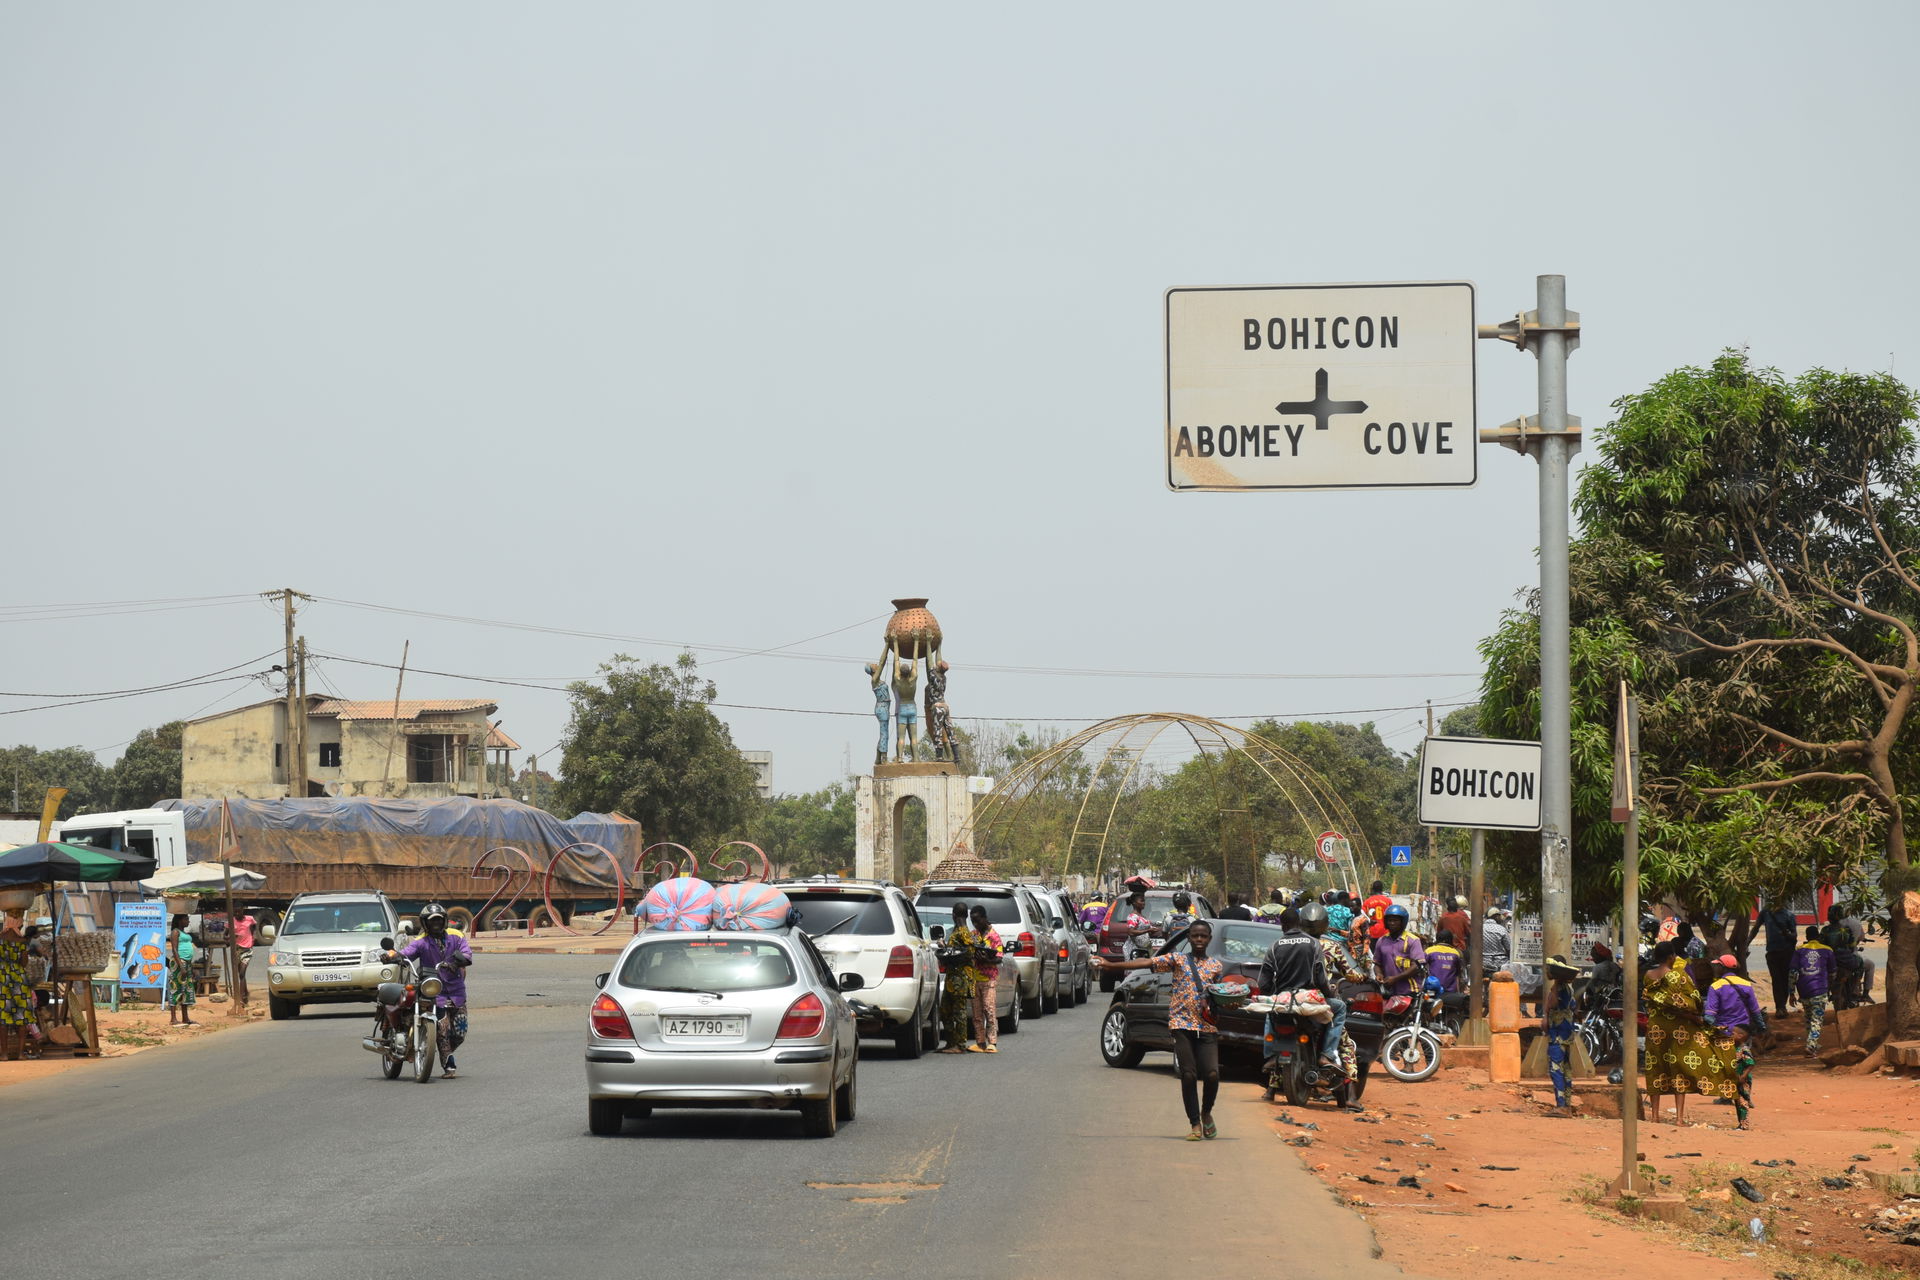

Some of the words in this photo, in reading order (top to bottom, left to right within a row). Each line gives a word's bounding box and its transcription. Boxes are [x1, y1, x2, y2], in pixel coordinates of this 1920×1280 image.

[1243, 316, 1399, 350] BOHICON
[1174, 424, 1305, 458] ABOMEY
[1363, 421, 1454, 456] COVE
[1430, 766, 1535, 800] BOHICON
[669, 1021, 688, 1034] AZ
[692, 1021, 723, 1034] 1790
